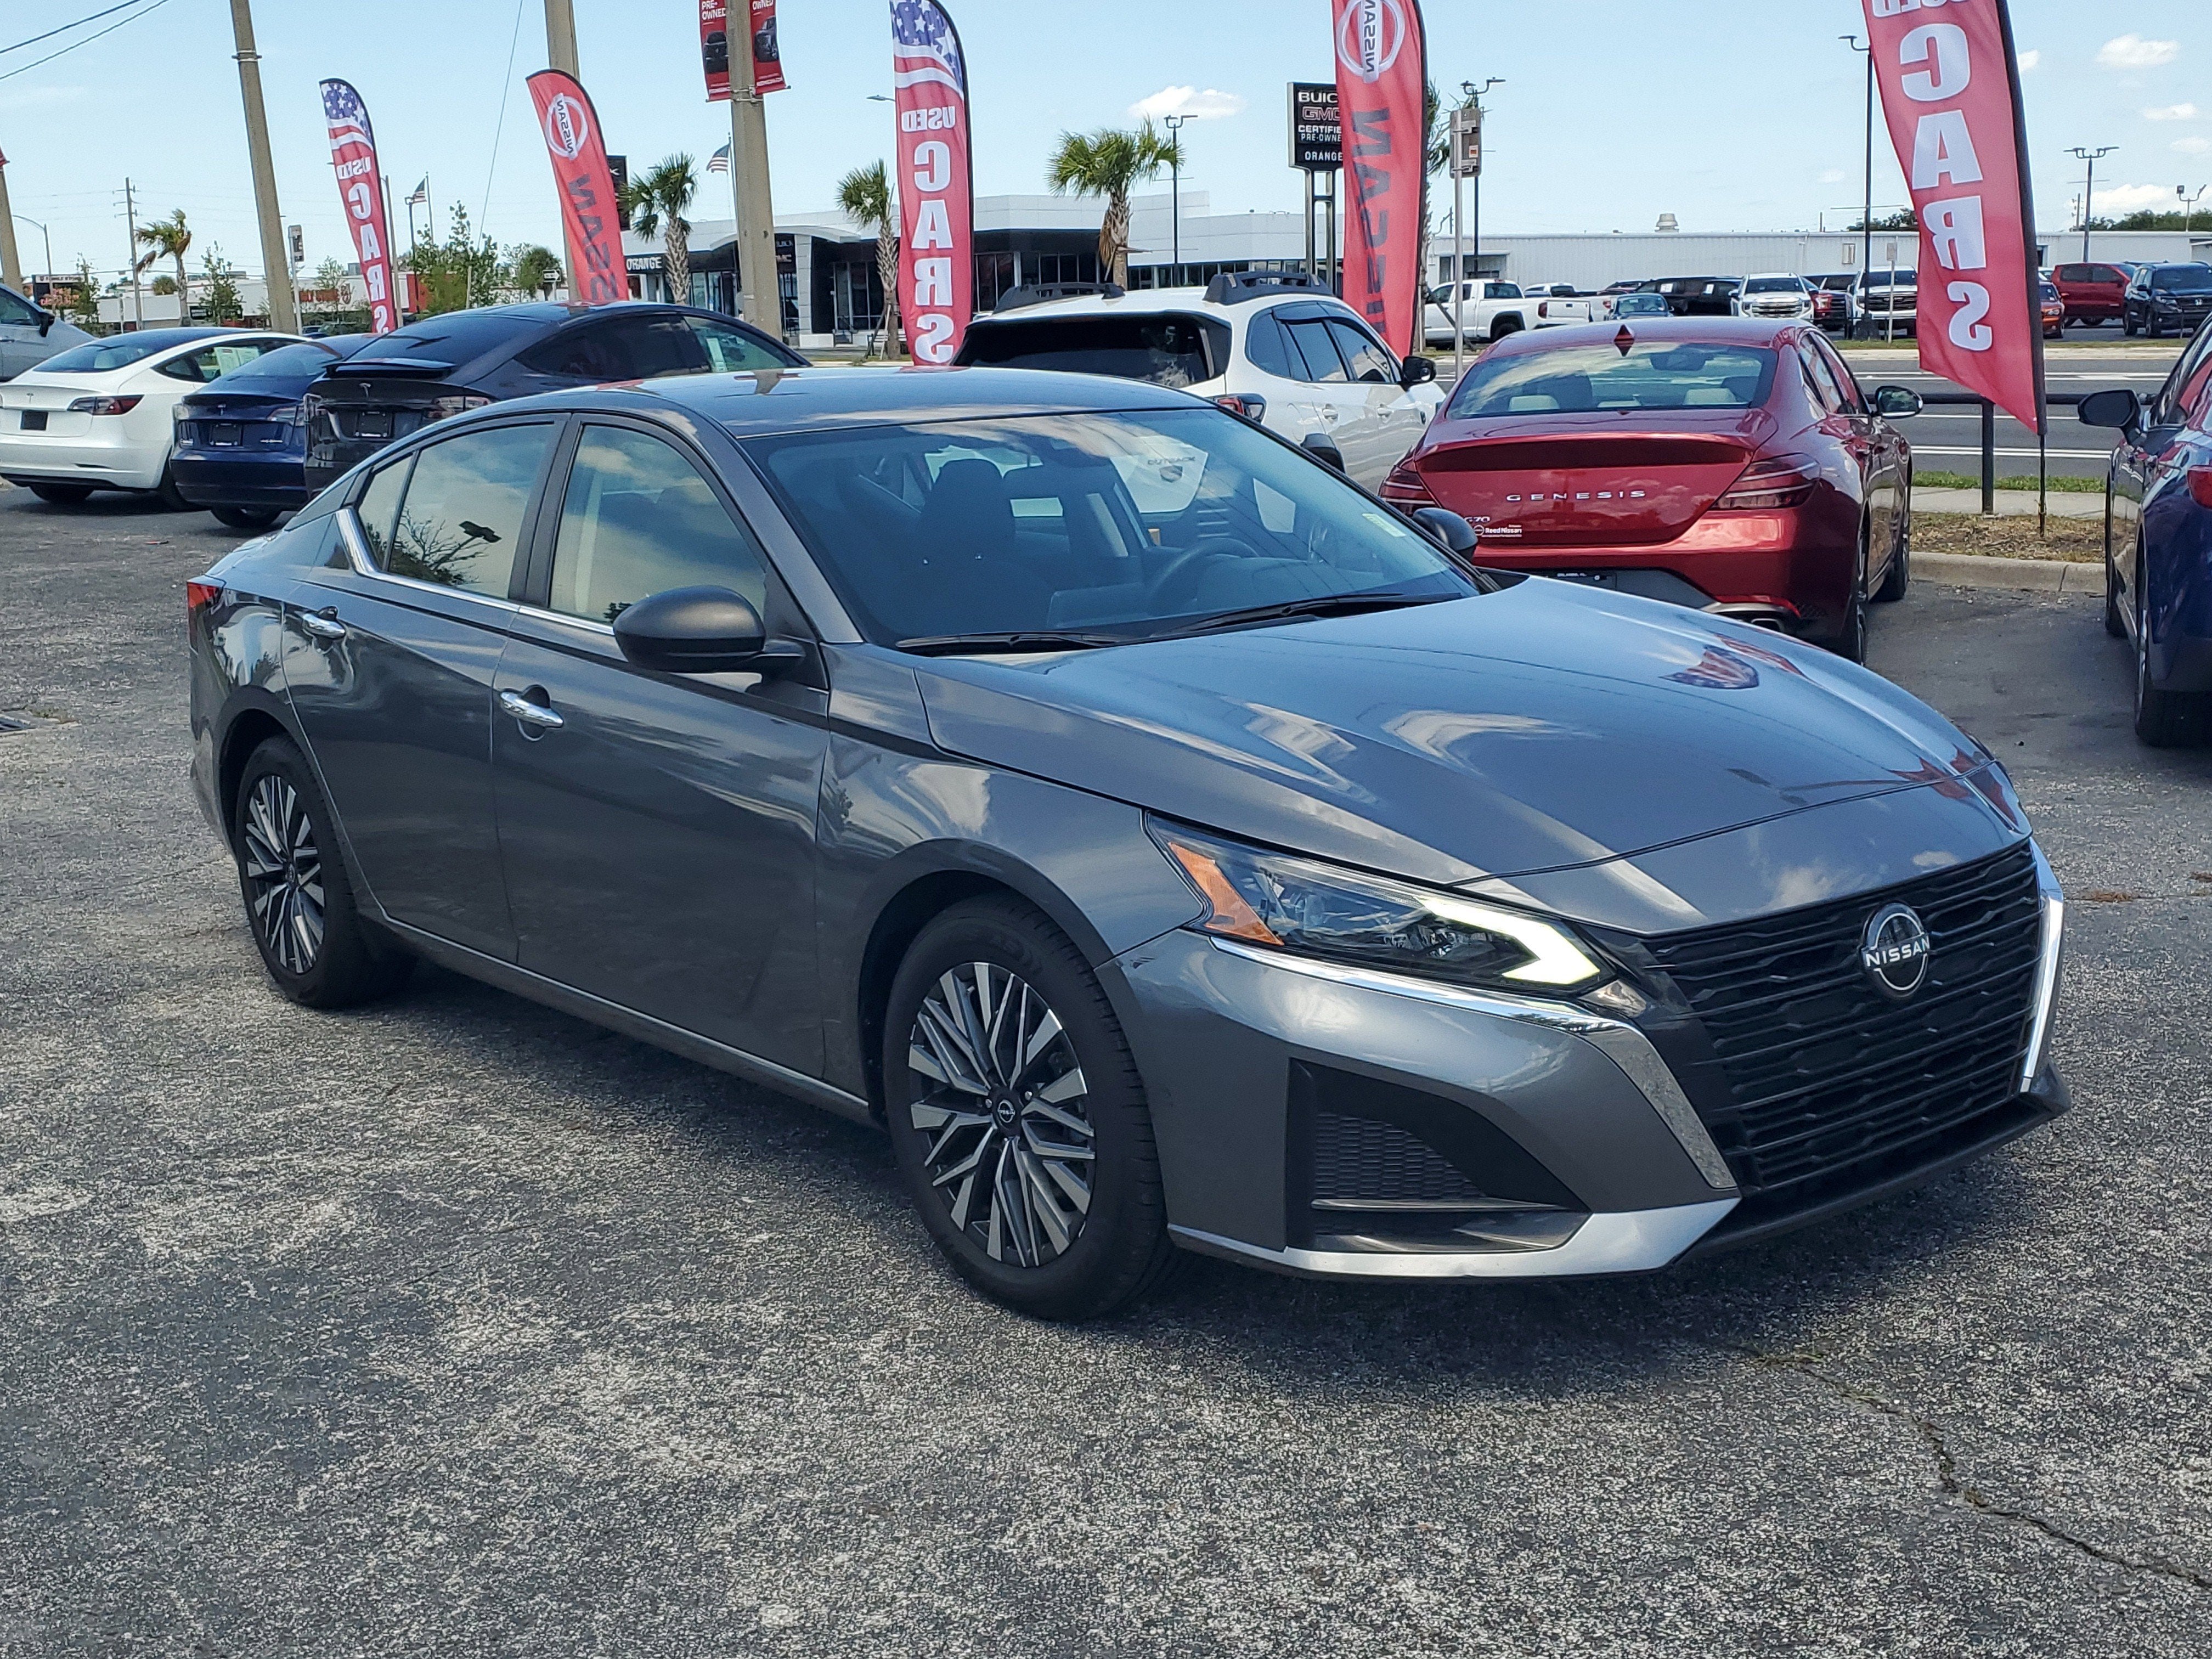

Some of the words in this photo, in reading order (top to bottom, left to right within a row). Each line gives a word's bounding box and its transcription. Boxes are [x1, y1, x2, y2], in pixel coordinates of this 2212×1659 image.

[1298, 92, 1338, 103] BUIC
[1298, 125, 1342, 134] CERTIFIE
[1301, 133, 1342, 142] PRE-OWNE
[1305, 151, 1343, 161] ORANGE
[626, 257, 662, 270] ORANGE
[1506, 490, 1645, 501] GENESIS
[1865, 935, 1930, 967] NISSAN
